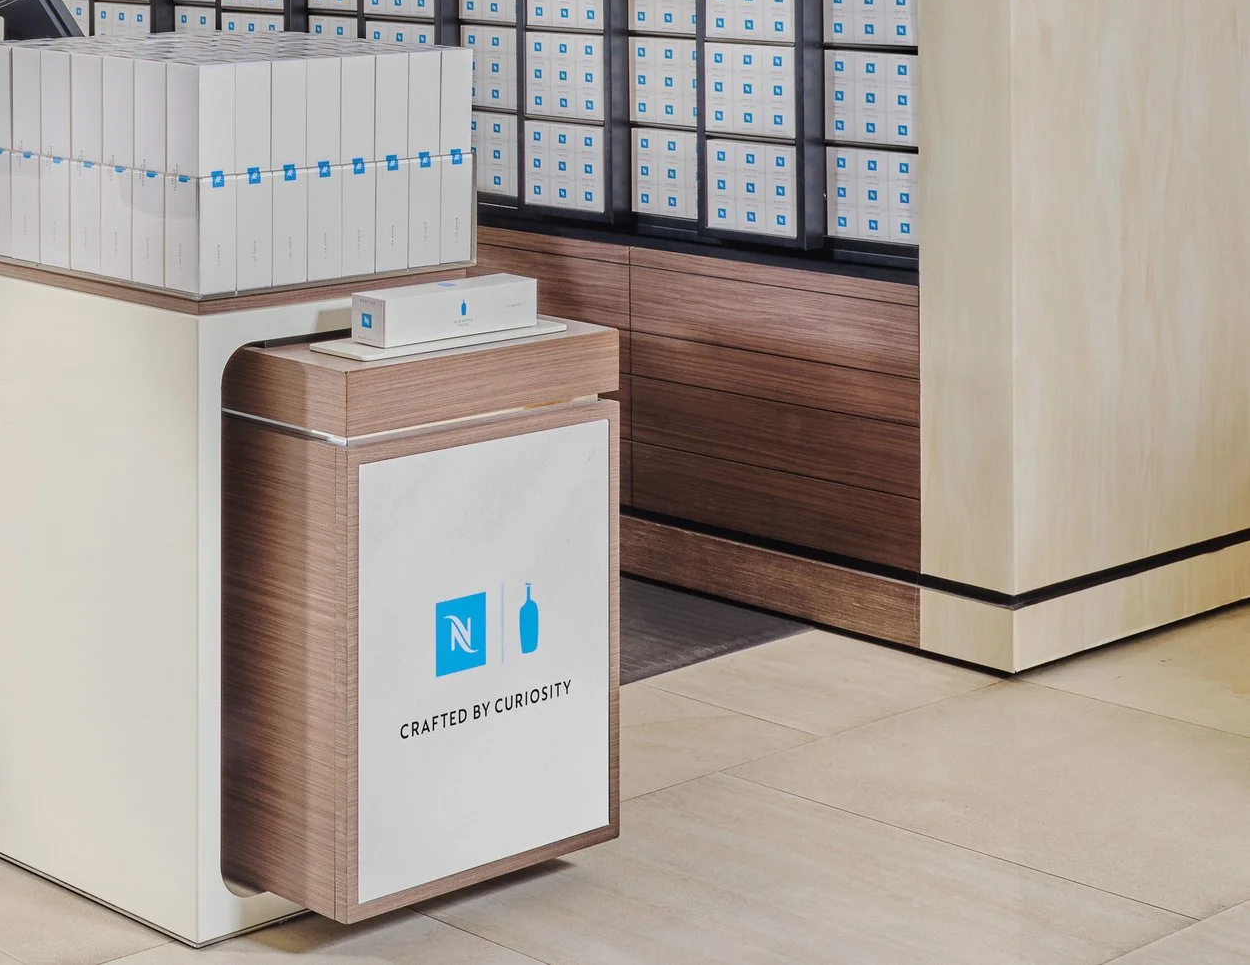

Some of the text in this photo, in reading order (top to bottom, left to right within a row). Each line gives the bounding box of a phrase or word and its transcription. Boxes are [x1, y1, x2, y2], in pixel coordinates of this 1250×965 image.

[443, 615, 479, 654] N
[399, 679, 572, 740] CRAFTED BY CURIOSITY
